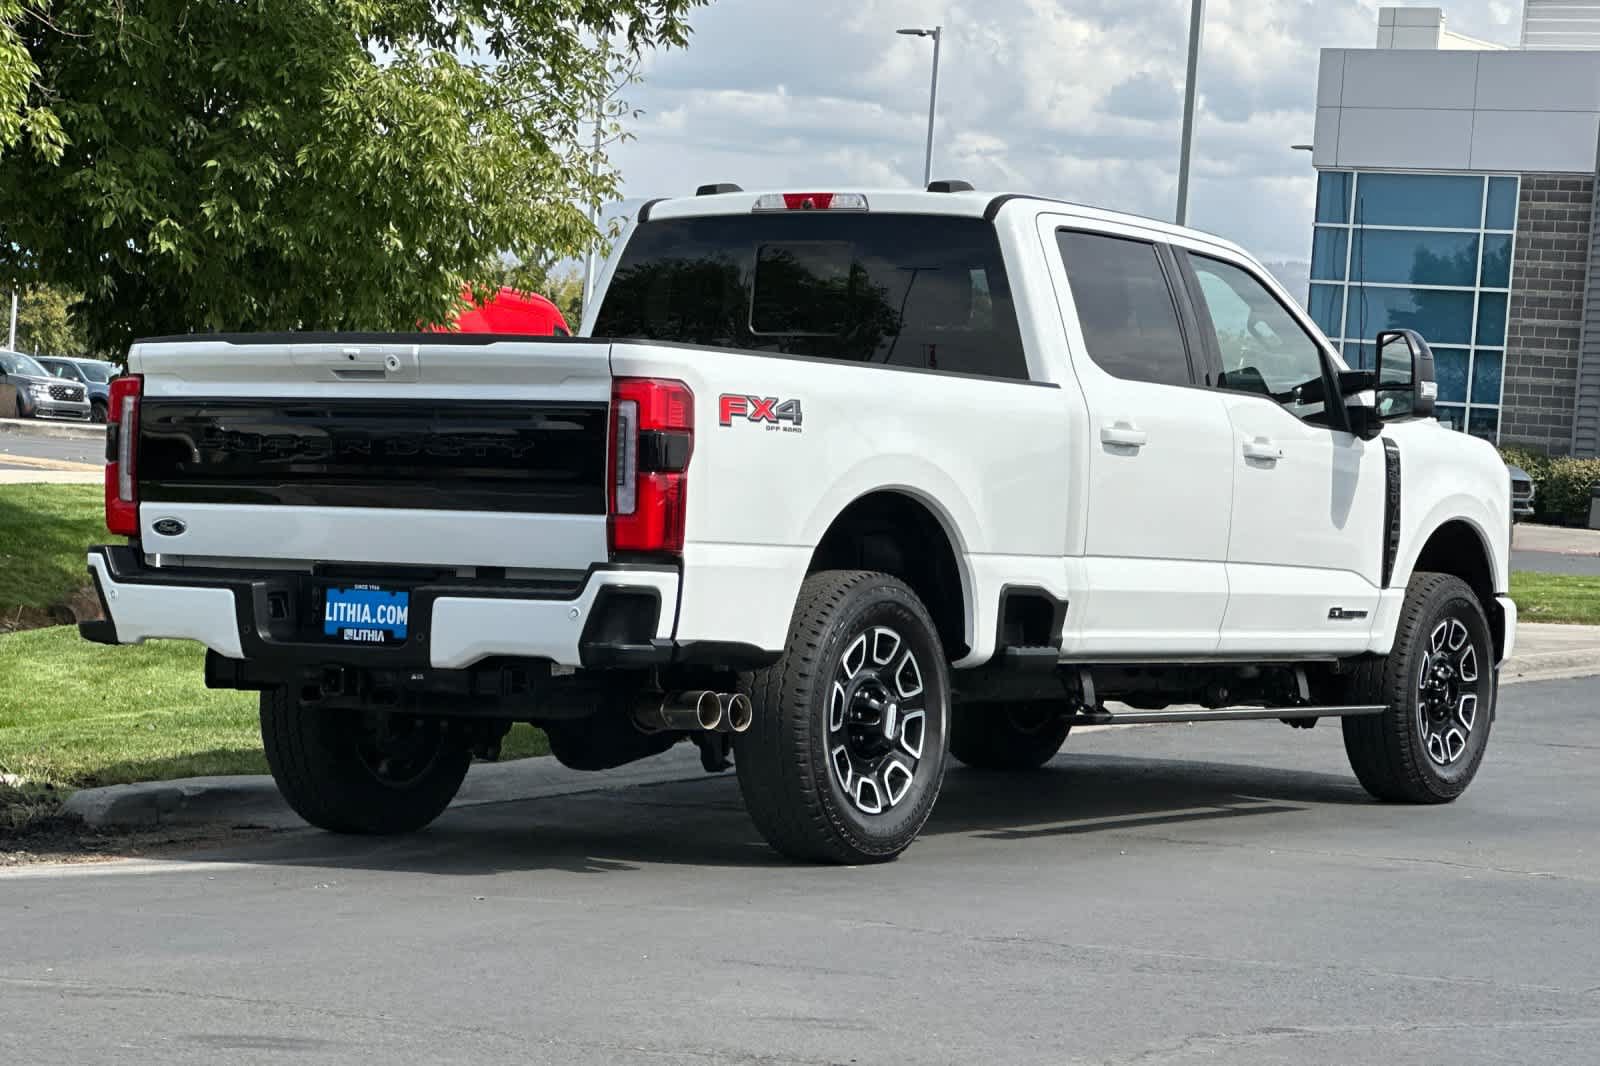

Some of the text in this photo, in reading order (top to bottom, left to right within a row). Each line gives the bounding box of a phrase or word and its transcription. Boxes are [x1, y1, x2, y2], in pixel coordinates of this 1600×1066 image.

[719, 393, 802, 427] FX4
[325, 601, 409, 625] LITHIA.COM
[353, 629, 384, 642] LITHIA
